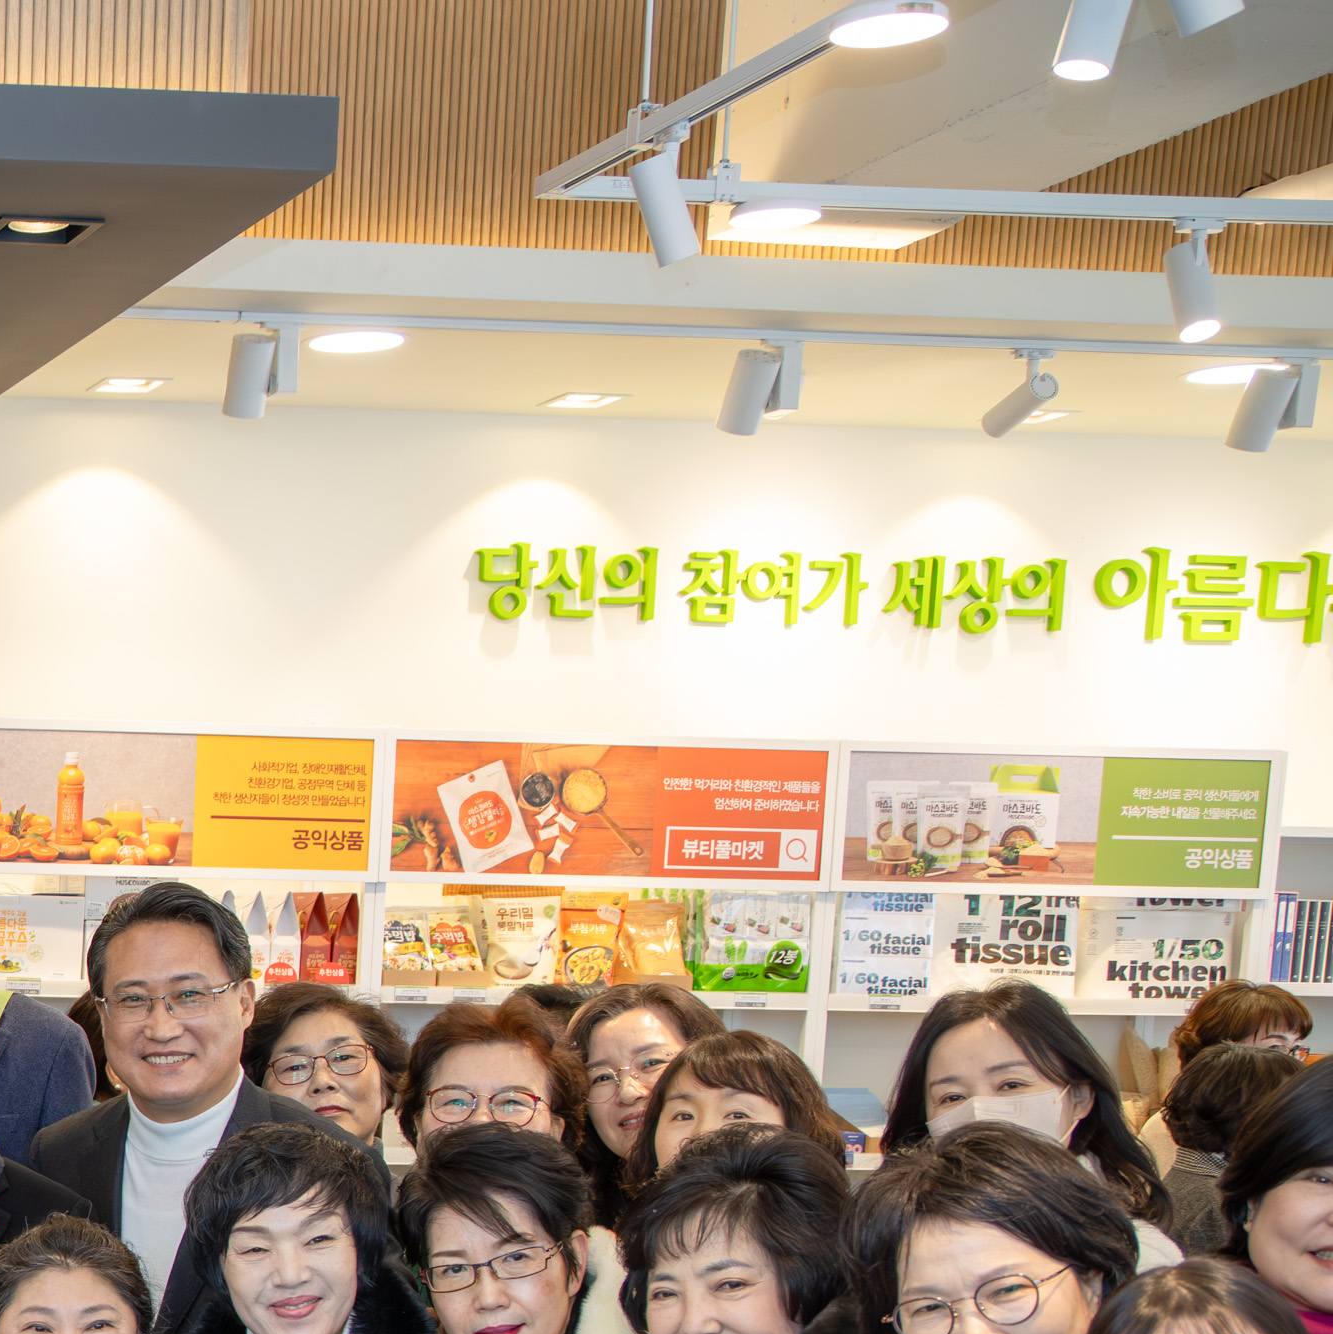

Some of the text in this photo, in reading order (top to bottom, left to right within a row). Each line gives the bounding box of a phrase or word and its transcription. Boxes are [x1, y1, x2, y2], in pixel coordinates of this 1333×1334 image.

[474, 541, 1333, 645] 당신의 참여가 세상의 아름다
[251, 761, 367, 776] 사회적기업, 장애인재활단체,
[247, 776, 367, 792] 친환경기업, 공정무역 단체 등
[663, 777, 821, 794] 안전한 먹거리와 친환경적인 제품들을
[213, 791, 366, 807] 착한 생산자들이 정성껏 만들었습니다
[1132, 787, 1259, 802] 착한 소비로 공익 생산자들에게
[714, 797, 820, 812] 엄선하여 준비하였습니다
[926, 803, 959, 813] 마스코바도
[1002, 803, 1042, 815] 마스코바도
[1120, 805, 1258, 820] 지속가능한 내일을 선물해주세요
[292, 829, 364, 851] 공익상품
[682, 839, 764, 860] 뷰티풀마켓
[1184, 848, 1253, 870] 공익상품
[496, 907, 534, 920] 우리밀
[872, 900, 924, 913] tissue
[569, 923, 608, 935] 부침가루
[1000, 914, 1068, 942] roll
[433, 931, 466, 943] 주먹밥
[843, 929, 931, 945] 1/60 facial
[769, 949, 799, 965] 12봉
[870, 943, 921, 956] tissue
[950, 936, 1072, 966] tissue
[1153, 939, 1225, 961] 1/50
[268, 967, 294, 977] 추천상품
[319, 967, 345, 977] 추천상품
[1106, 960, 1227, 981] kitchen
[840, 973, 928, 988] 1/60 facial
[867, 985, 918, 996] tissue
